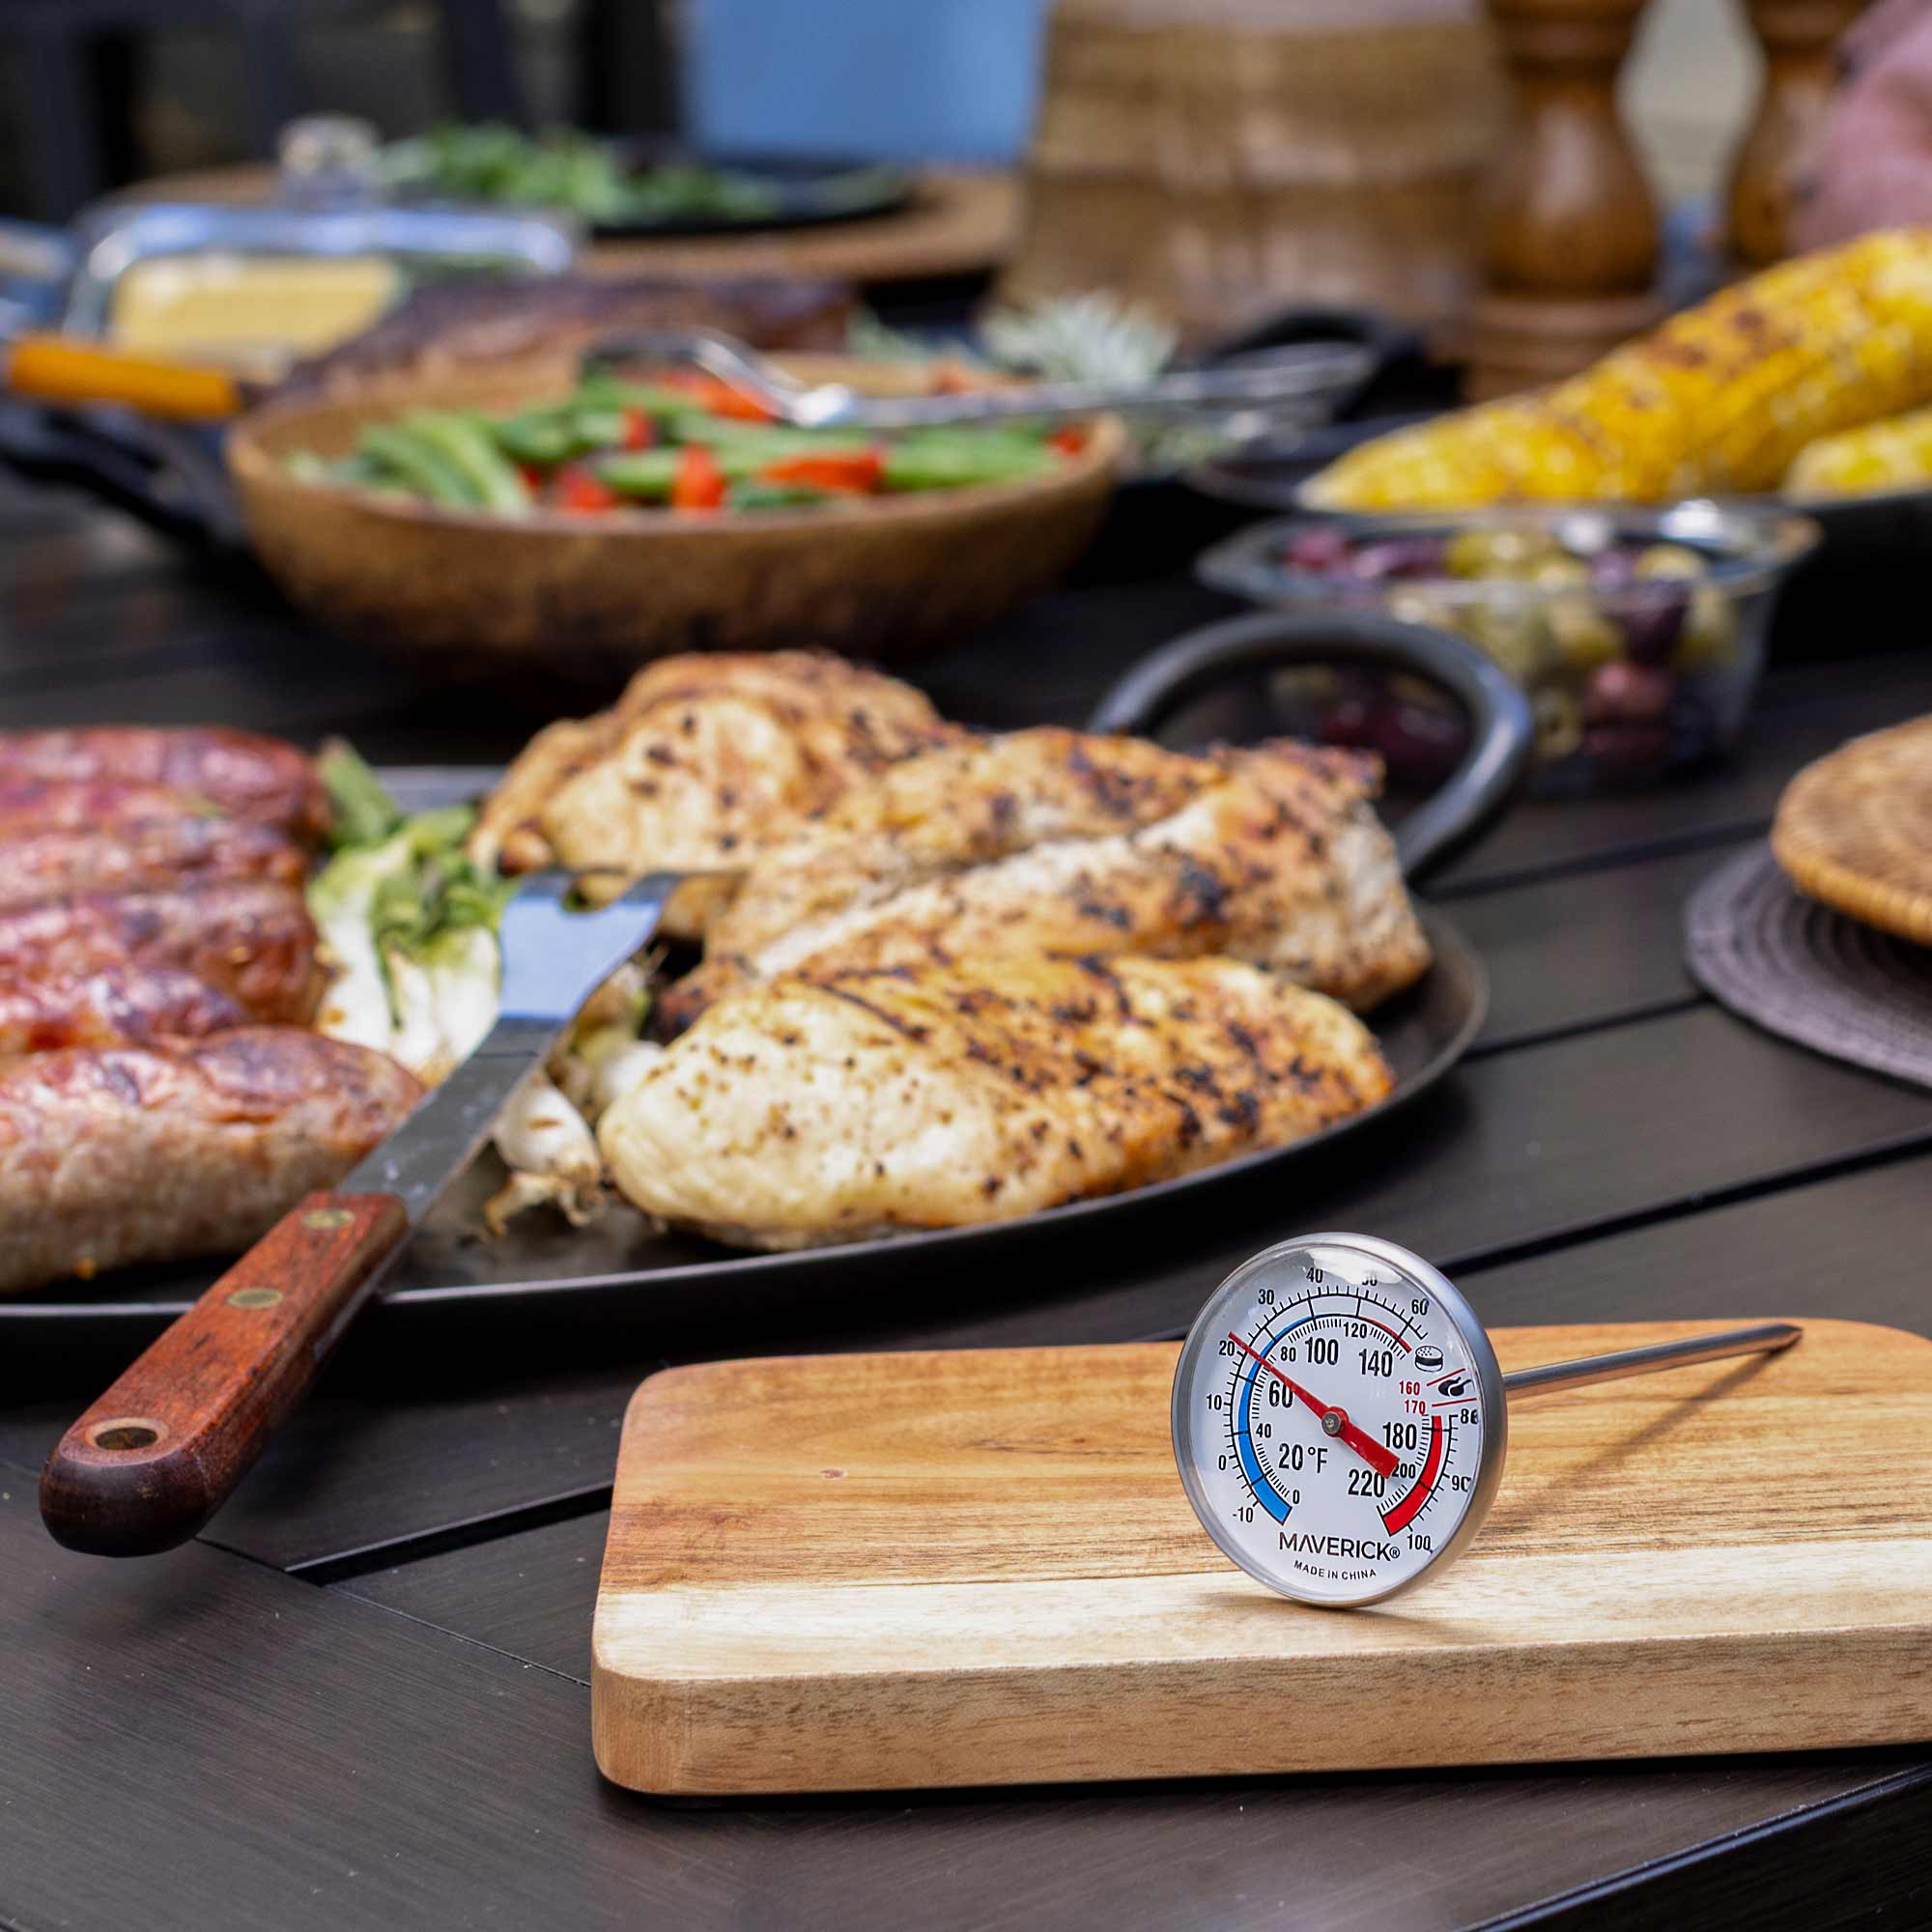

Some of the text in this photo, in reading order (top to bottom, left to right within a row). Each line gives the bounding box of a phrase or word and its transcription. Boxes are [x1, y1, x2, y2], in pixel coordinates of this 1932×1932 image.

[1306, 1267, 1323, 1283] 40
[1258, 1289, 1274, 1305] 30
[1411, 1298, 1429, 1316] 60
[1344, 1321, 1367, 1338] 120
[1219, 1340, 1235, 1356] 20
[1280, 1347, 1296, 1362] 80
[1305, 1337, 1339, 1365] 100
[1358, 1349, 1393, 1378] 140
[1268, 1380, 1293, 1408] 60
[1399, 1380, 1420, 1395] 160
[1207, 1394, 1222, 1410] 10
[1405, 1399, 1427, 1414] 170
[1256, 1423, 1271, 1438] 40
[1382, 1422, 1417, 1450] 180
[1218, 1455, 1227, 1470] 0
[1348, 1468, 1385, 1497] 220
[1293, 1490, 1300, 1505] 0
[1233, 1507, 1254, 1523] -10
[1407, 1534, 1431, 1551] 100
[1294, 1560, 1377, 1580] MADE IN CHINA
